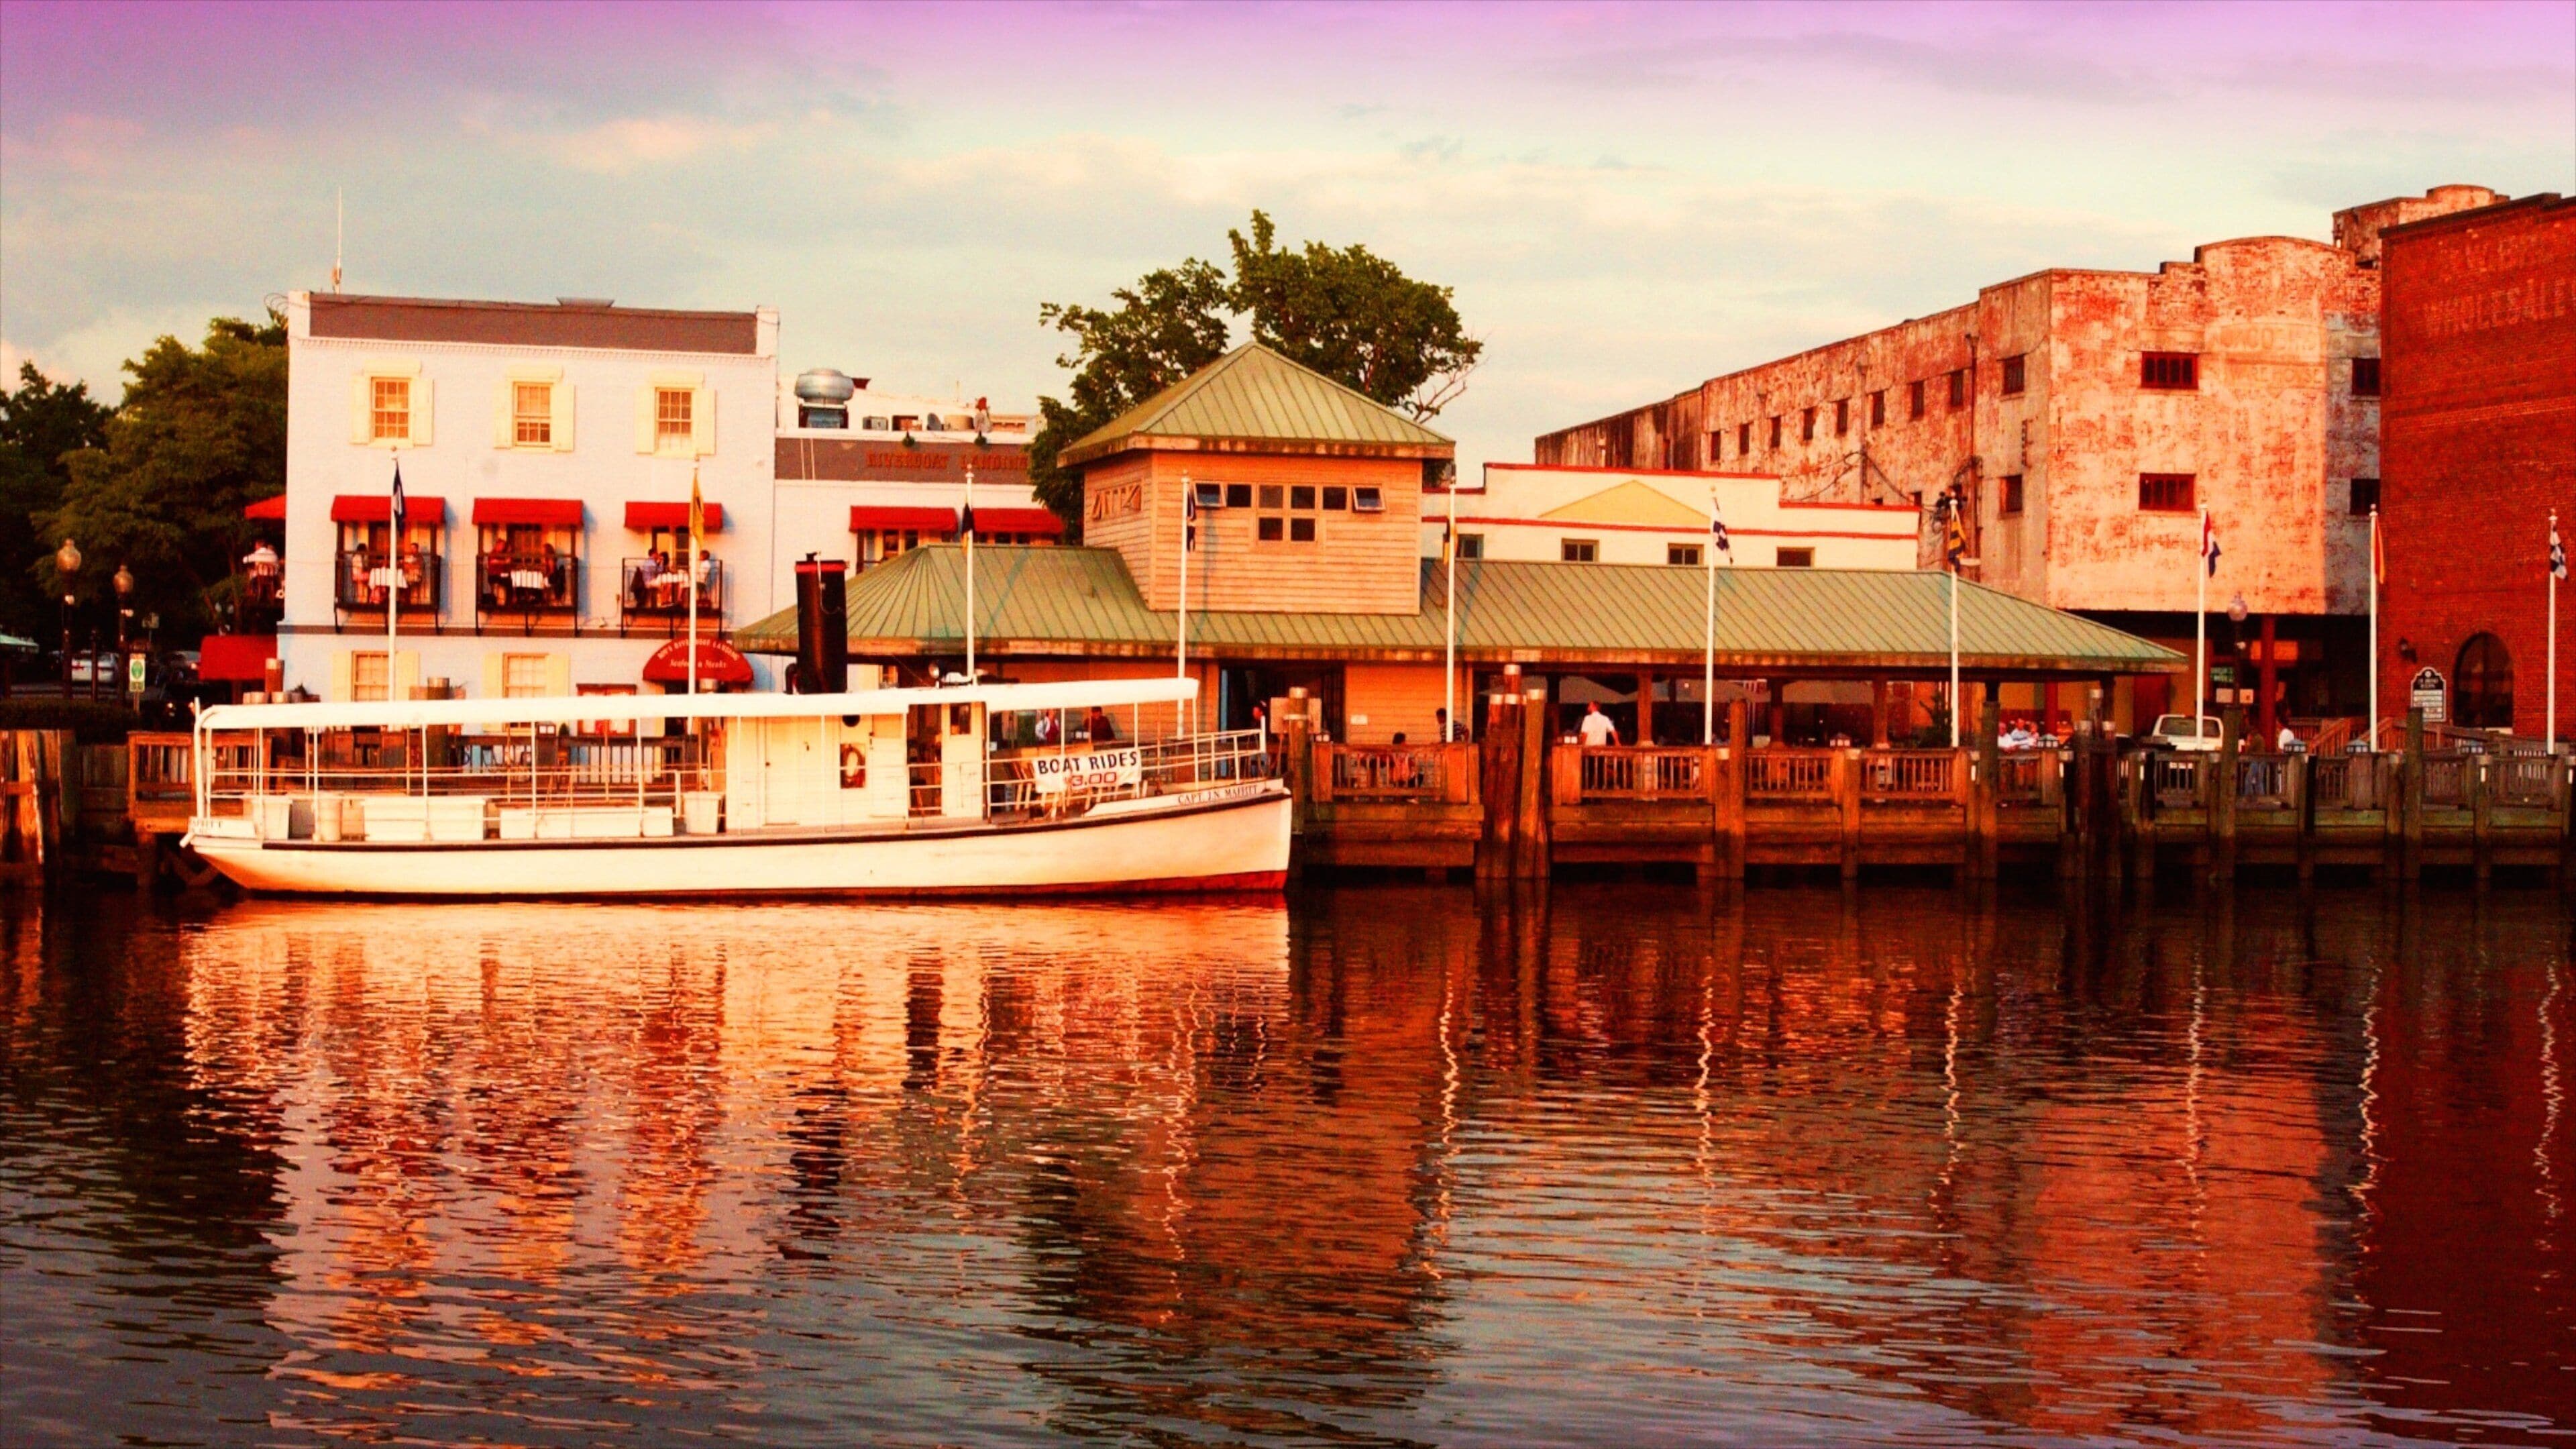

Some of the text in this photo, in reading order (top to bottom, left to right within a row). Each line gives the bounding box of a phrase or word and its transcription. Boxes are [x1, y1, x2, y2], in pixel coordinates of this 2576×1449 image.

[867, 451, 950, 469] RIVERBOAT
[1038, 751, 1138, 774] BOAT RIDES
